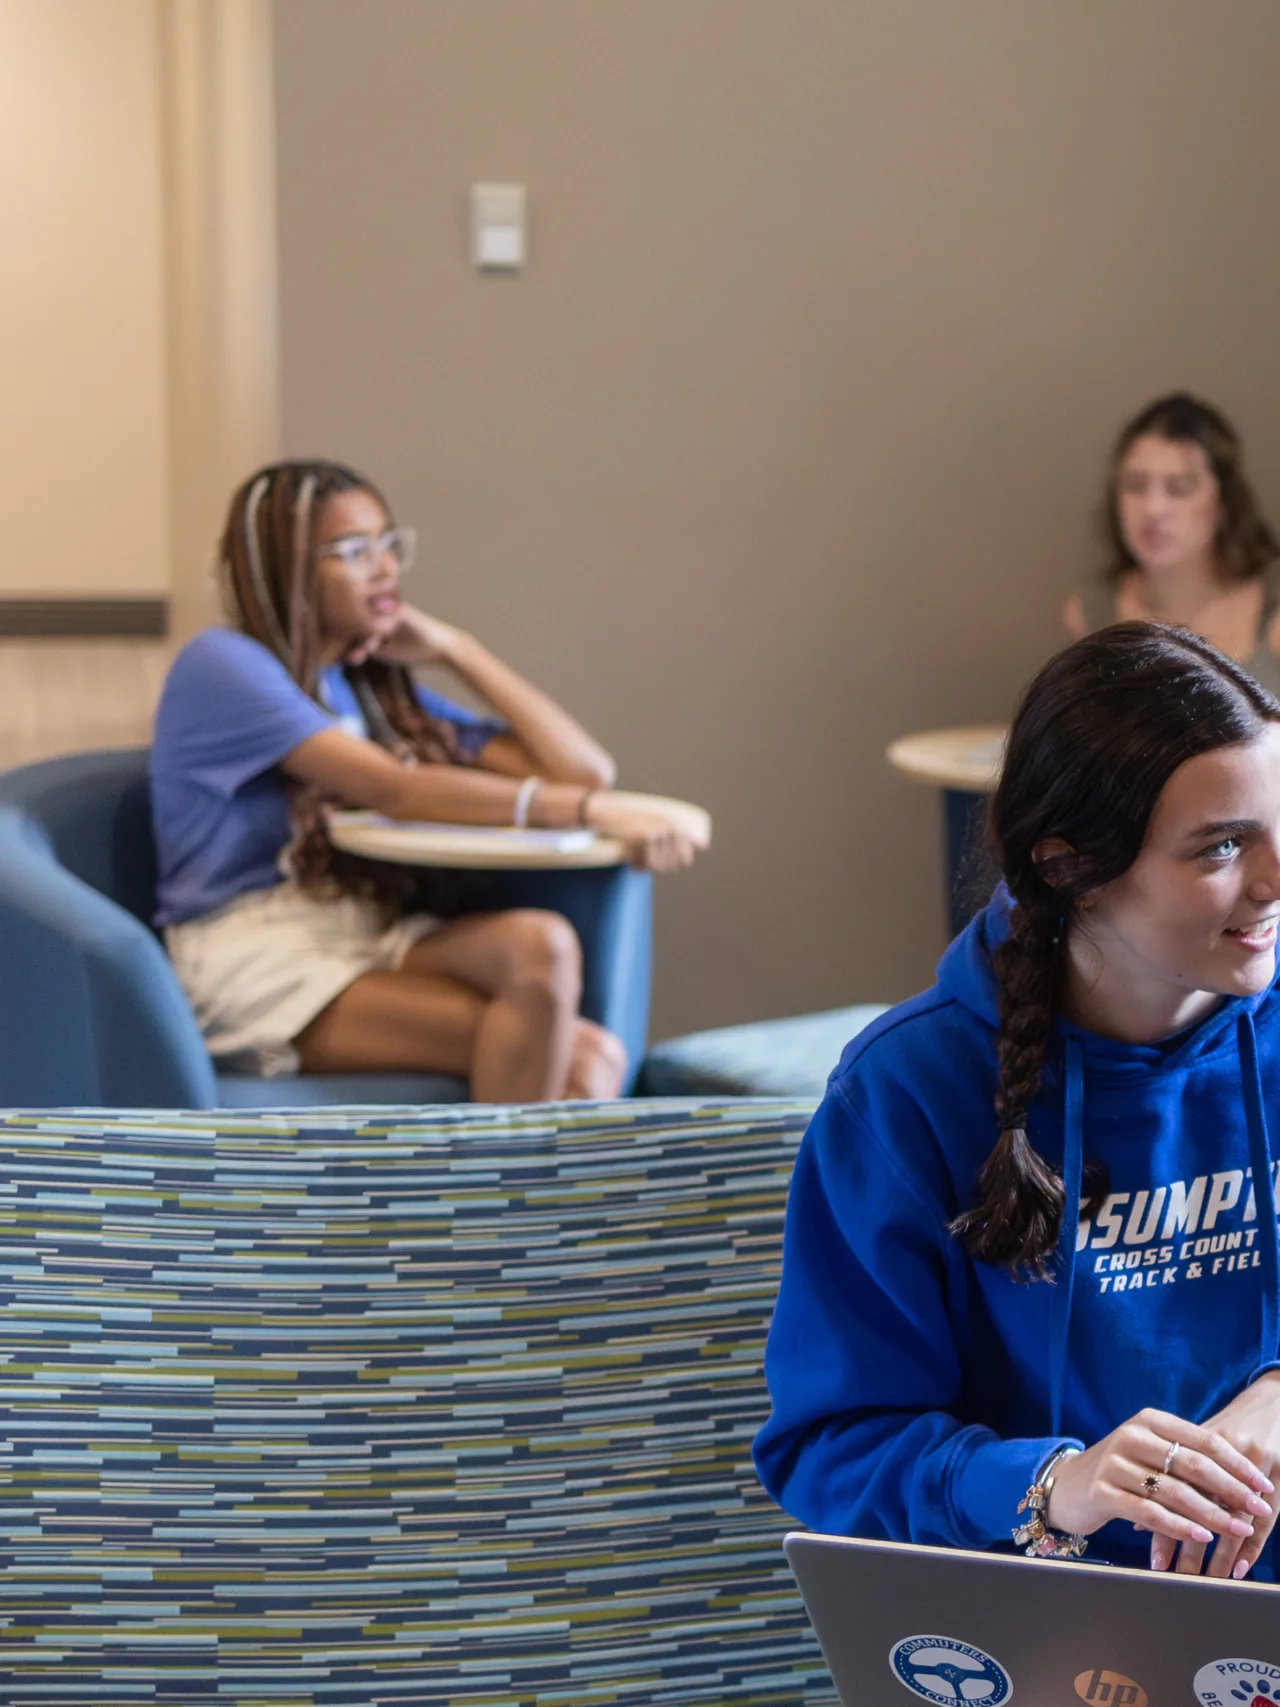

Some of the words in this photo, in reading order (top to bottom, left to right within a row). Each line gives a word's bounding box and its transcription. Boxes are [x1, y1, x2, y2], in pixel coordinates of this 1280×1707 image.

[1093, 1245, 1175, 1273] CROSS
[1100, 1266, 1179, 1294] TRACK
[1185, 1262, 1203, 1280] &
[1211, 1250, 1261, 1275] FIEL
[899, 1637, 986, 1663] COMMUTERS
[925, 1690, 997, 1707] CONNECT
[1085, 1669, 1139, 1707] hp
[1201, 1692, 1224, 1707] BE
